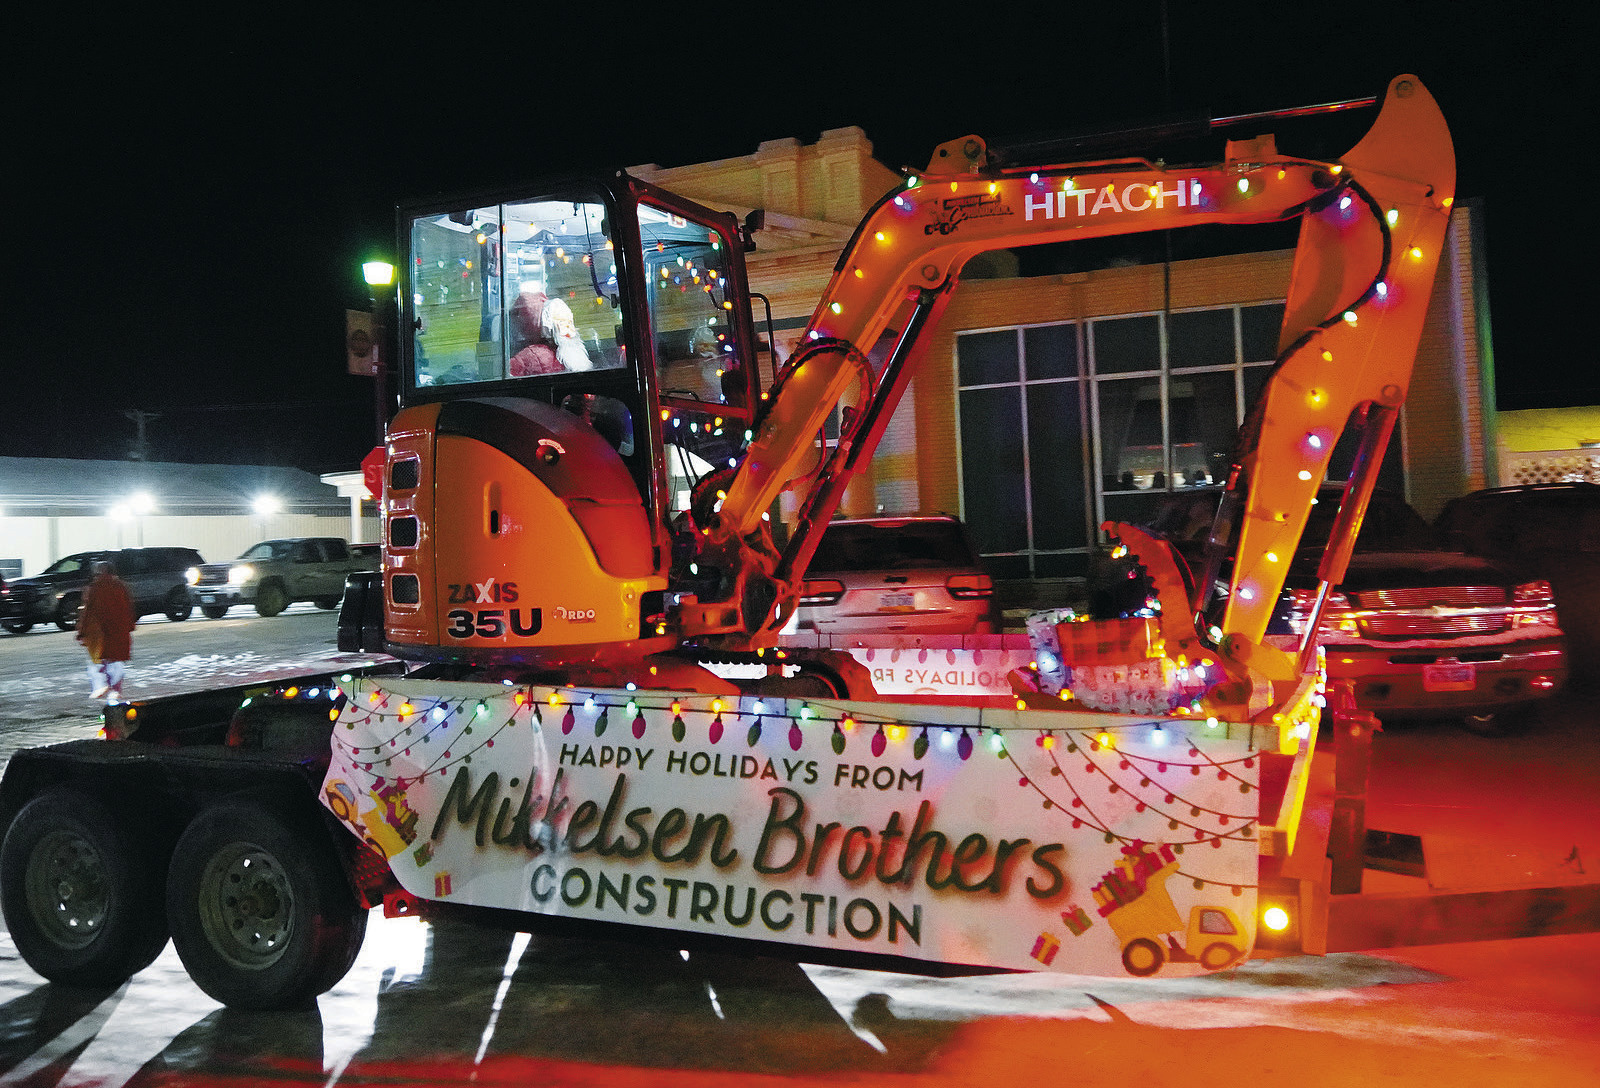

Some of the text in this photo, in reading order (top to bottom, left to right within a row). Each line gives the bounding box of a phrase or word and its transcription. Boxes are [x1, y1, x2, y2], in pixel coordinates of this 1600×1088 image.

[1025, 177, 1201, 221] HITACHI
[448, 577, 519, 604] ZAXIS
[559, 743, 924, 792] HAPPY HOLIDAYS FROM
[430, 765, 1065, 899] Mikkelsen Brothers
[530, 863, 923, 946] CONSTRUCTION
